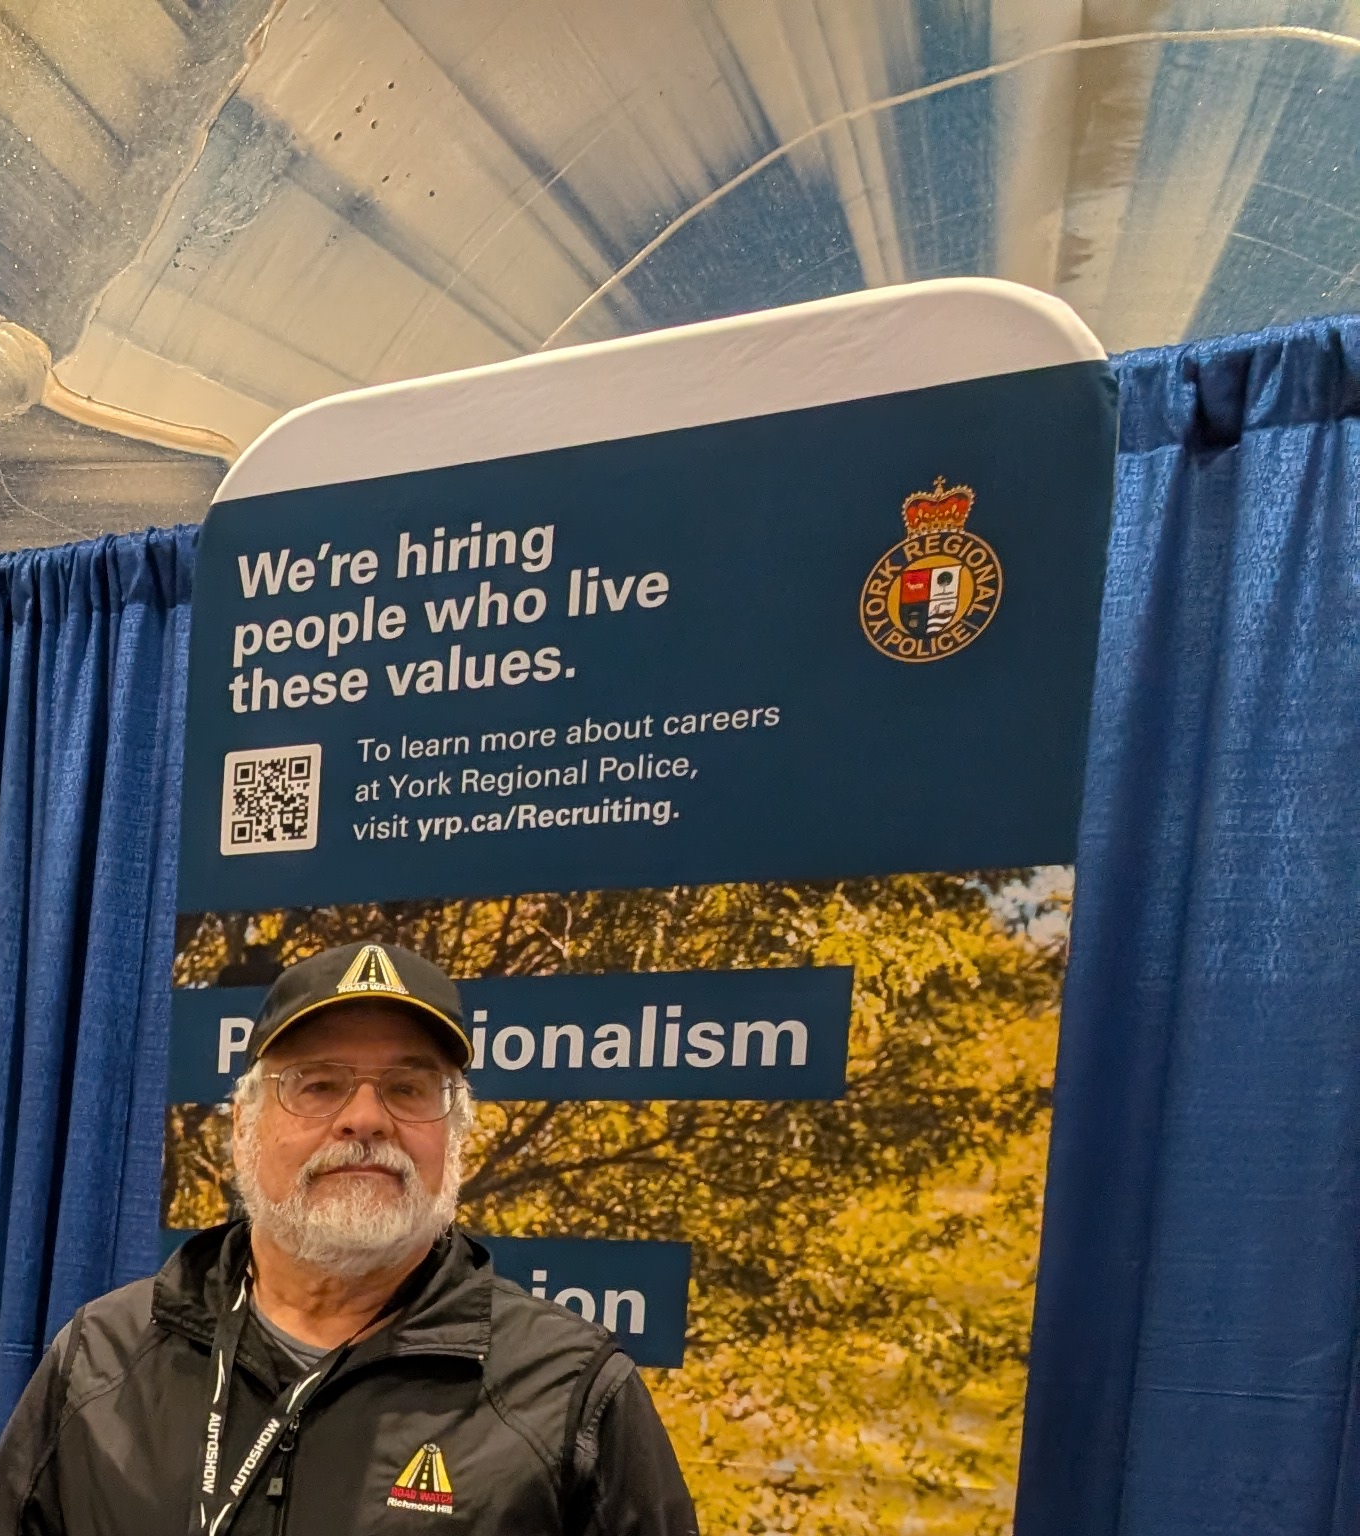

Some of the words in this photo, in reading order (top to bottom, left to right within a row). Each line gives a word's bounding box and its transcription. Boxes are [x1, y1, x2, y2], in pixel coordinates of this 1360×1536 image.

[238, 543, 379, 599] We're
[397, 522, 555, 578] hiring
[866, 558, 903, 635] YORK
[903, 534, 996, 617] REGIONAL
[232, 596, 407, 667] people
[424, 581, 547, 633] who
[568, 567, 669, 617] live
[884, 624, 971, 657] POLICE
[228, 667, 368, 713] these
[385, 644, 576, 697] values.
[358, 738, 391, 763] To
[401, 734, 470, 761] learn
[481, 725, 556, 753] more
[565, 714, 654, 745] about
[663, 705, 780, 736] careers
[355, 778, 380, 803] at
[389, 770, 452, 799] York
[461, 760, 587, 797] Regional
[599, 753, 699, 783] Police,
[353, 815, 409, 841] visit
[417, 797, 680, 842] yrp.ca/Recruiting.
[202, 1412, 222, 1494] AUTOSHOW
[230, 1418, 280, 1496] AUTOSHOW
[387, 1497, 436, 1512] Richmond
